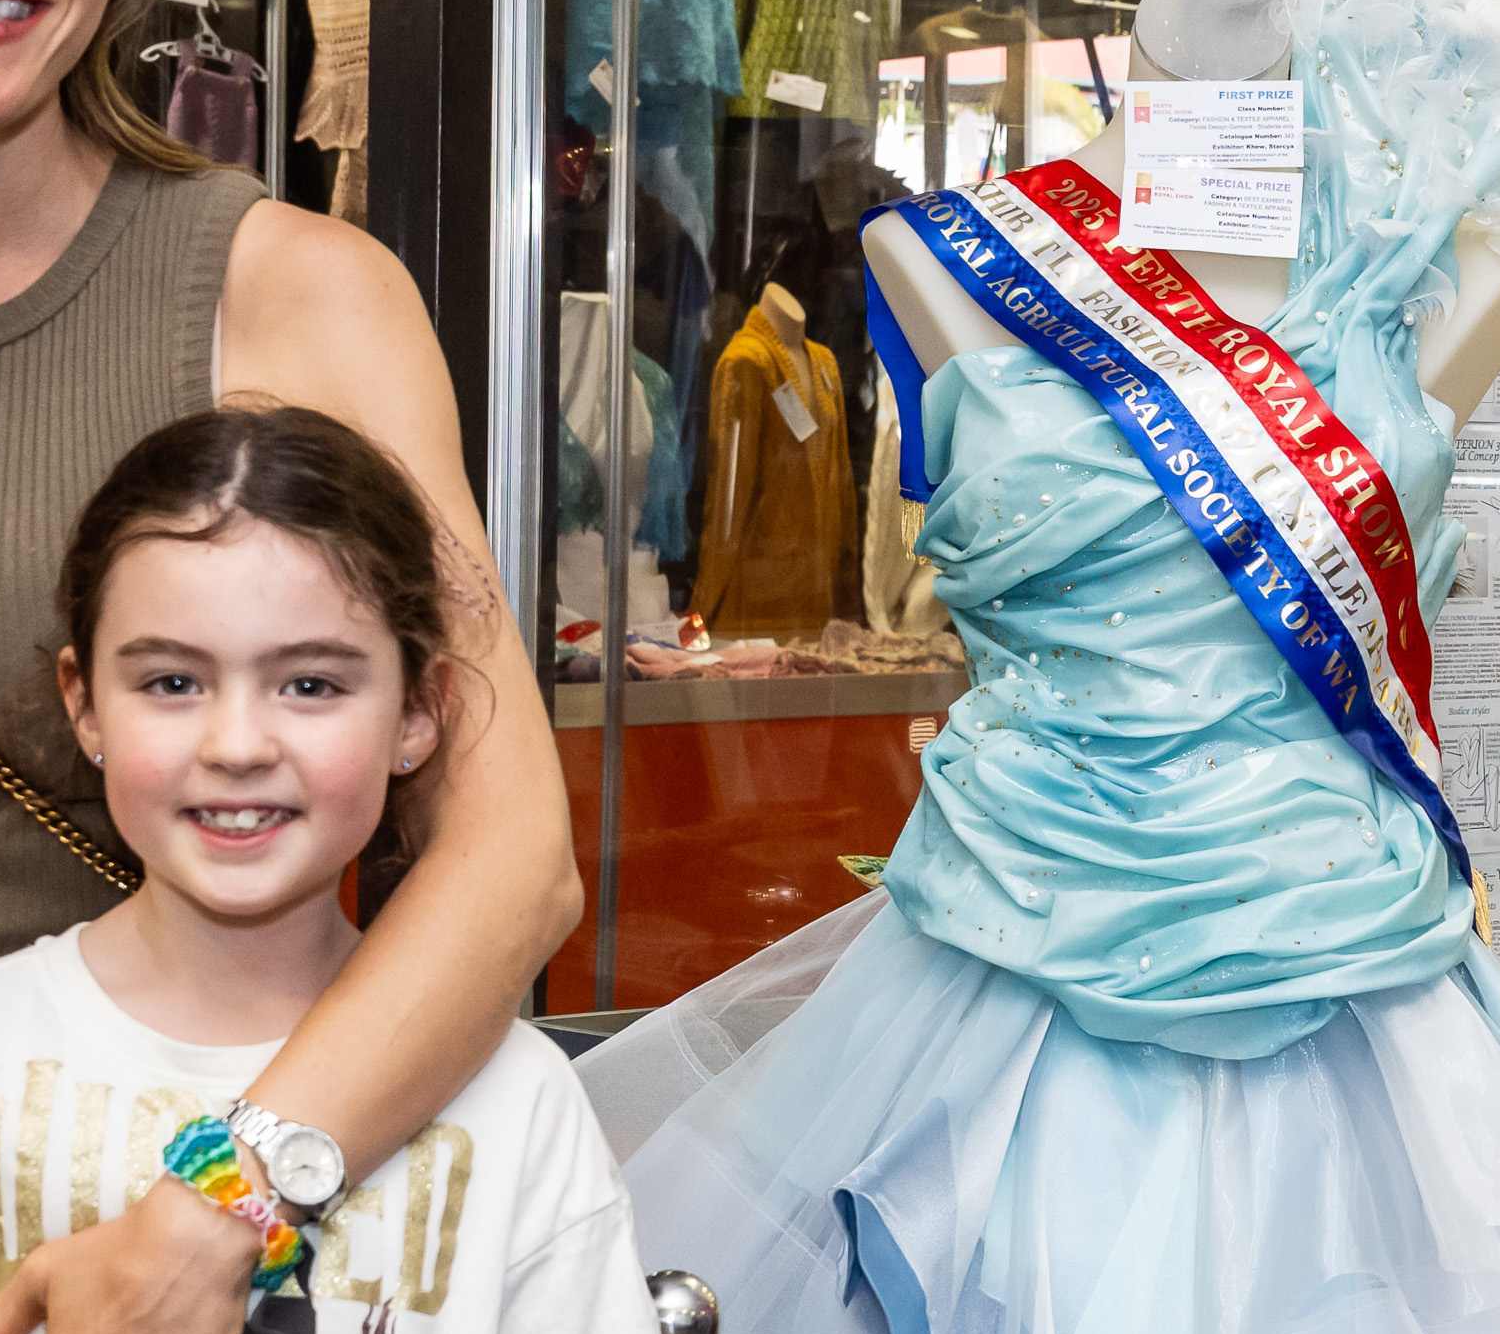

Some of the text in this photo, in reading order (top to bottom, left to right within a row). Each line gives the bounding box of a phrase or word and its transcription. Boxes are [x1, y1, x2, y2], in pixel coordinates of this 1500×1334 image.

[1219, 90, 1293, 99] FIRST PRIZE
[1200, 178, 1291, 192] SPECIAL PRIZE
[1210, 194, 1242, 202] Category:
[1078, 289, 1204, 380] FASHION
[1046, 178, 1118, 231] 2025
[1208, 327, 1326, 450] ROYAL
[1313, 445, 1409, 570] SHOW
[909, 189, 997, 279] ROYAL
[986, 275, 1176, 452] AGRICULTURAL
[1165, 447, 1294, 600] SOCIETY
[1278, 599, 1330, 649] OF
[1320, 649, 1361, 715] WA
